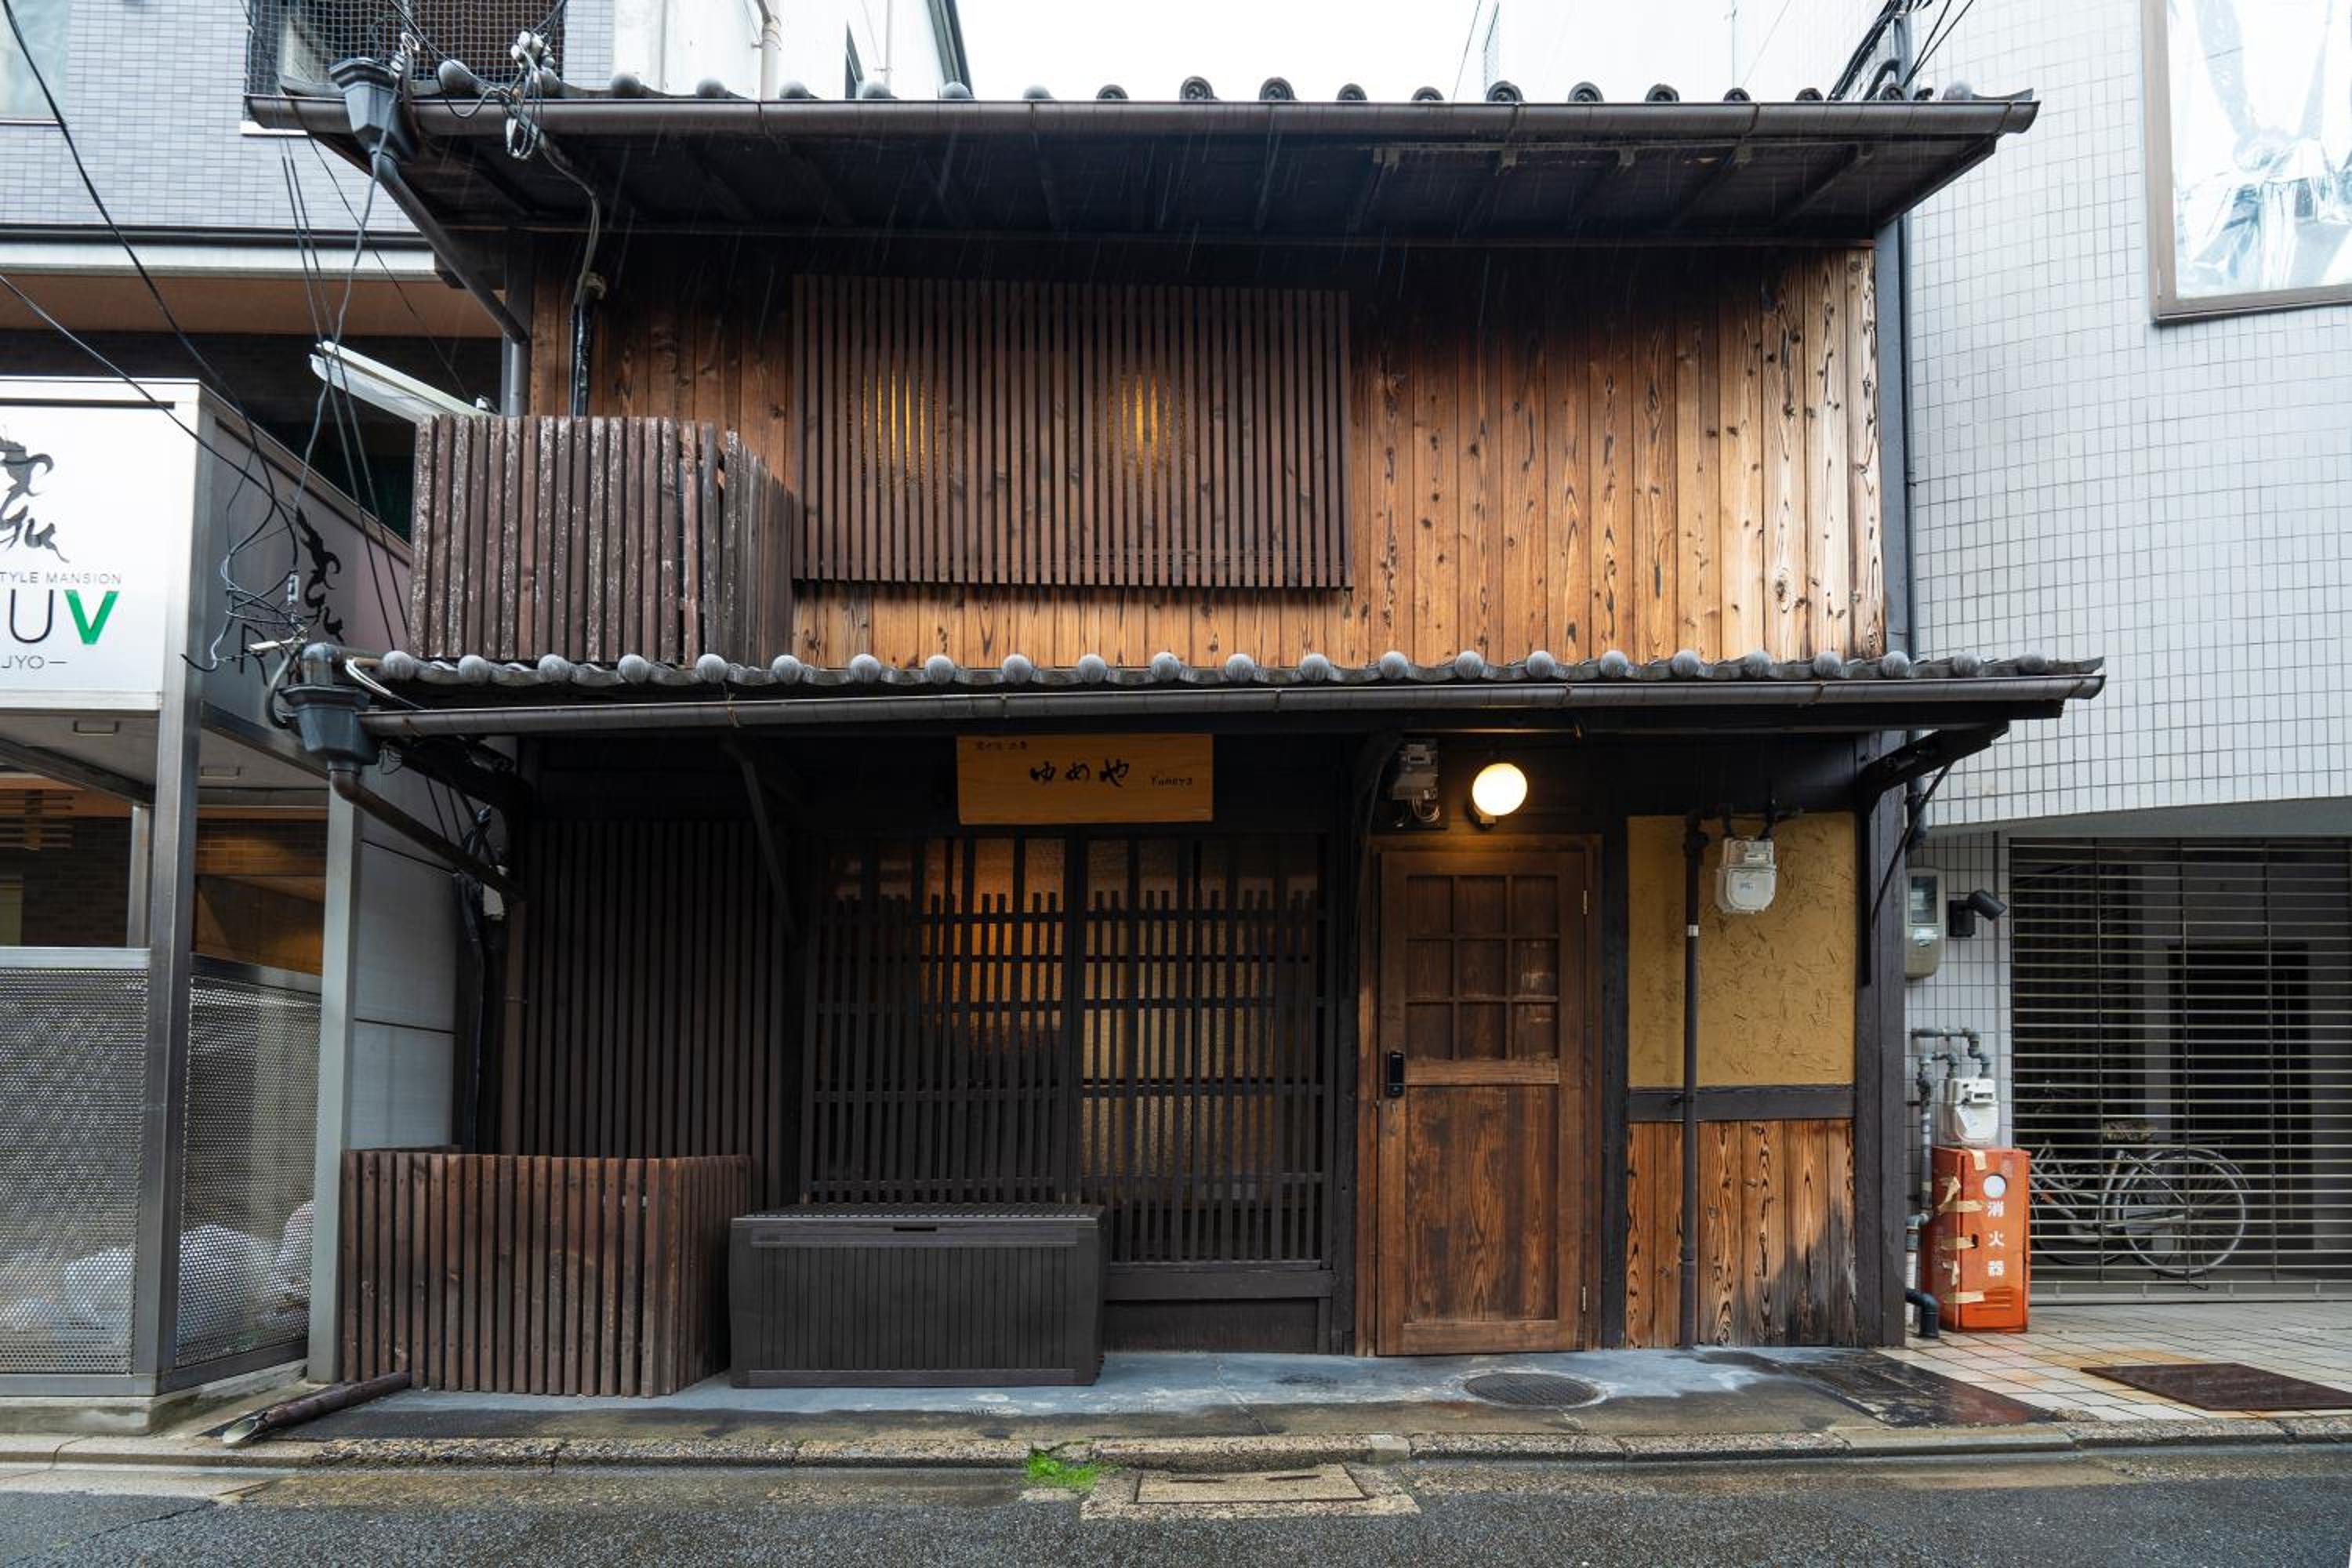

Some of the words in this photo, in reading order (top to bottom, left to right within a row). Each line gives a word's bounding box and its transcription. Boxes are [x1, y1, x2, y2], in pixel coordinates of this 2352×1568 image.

[45, 572, 122, 584] MANSION
[1987, 1200, 2005, 1277] 消火器
